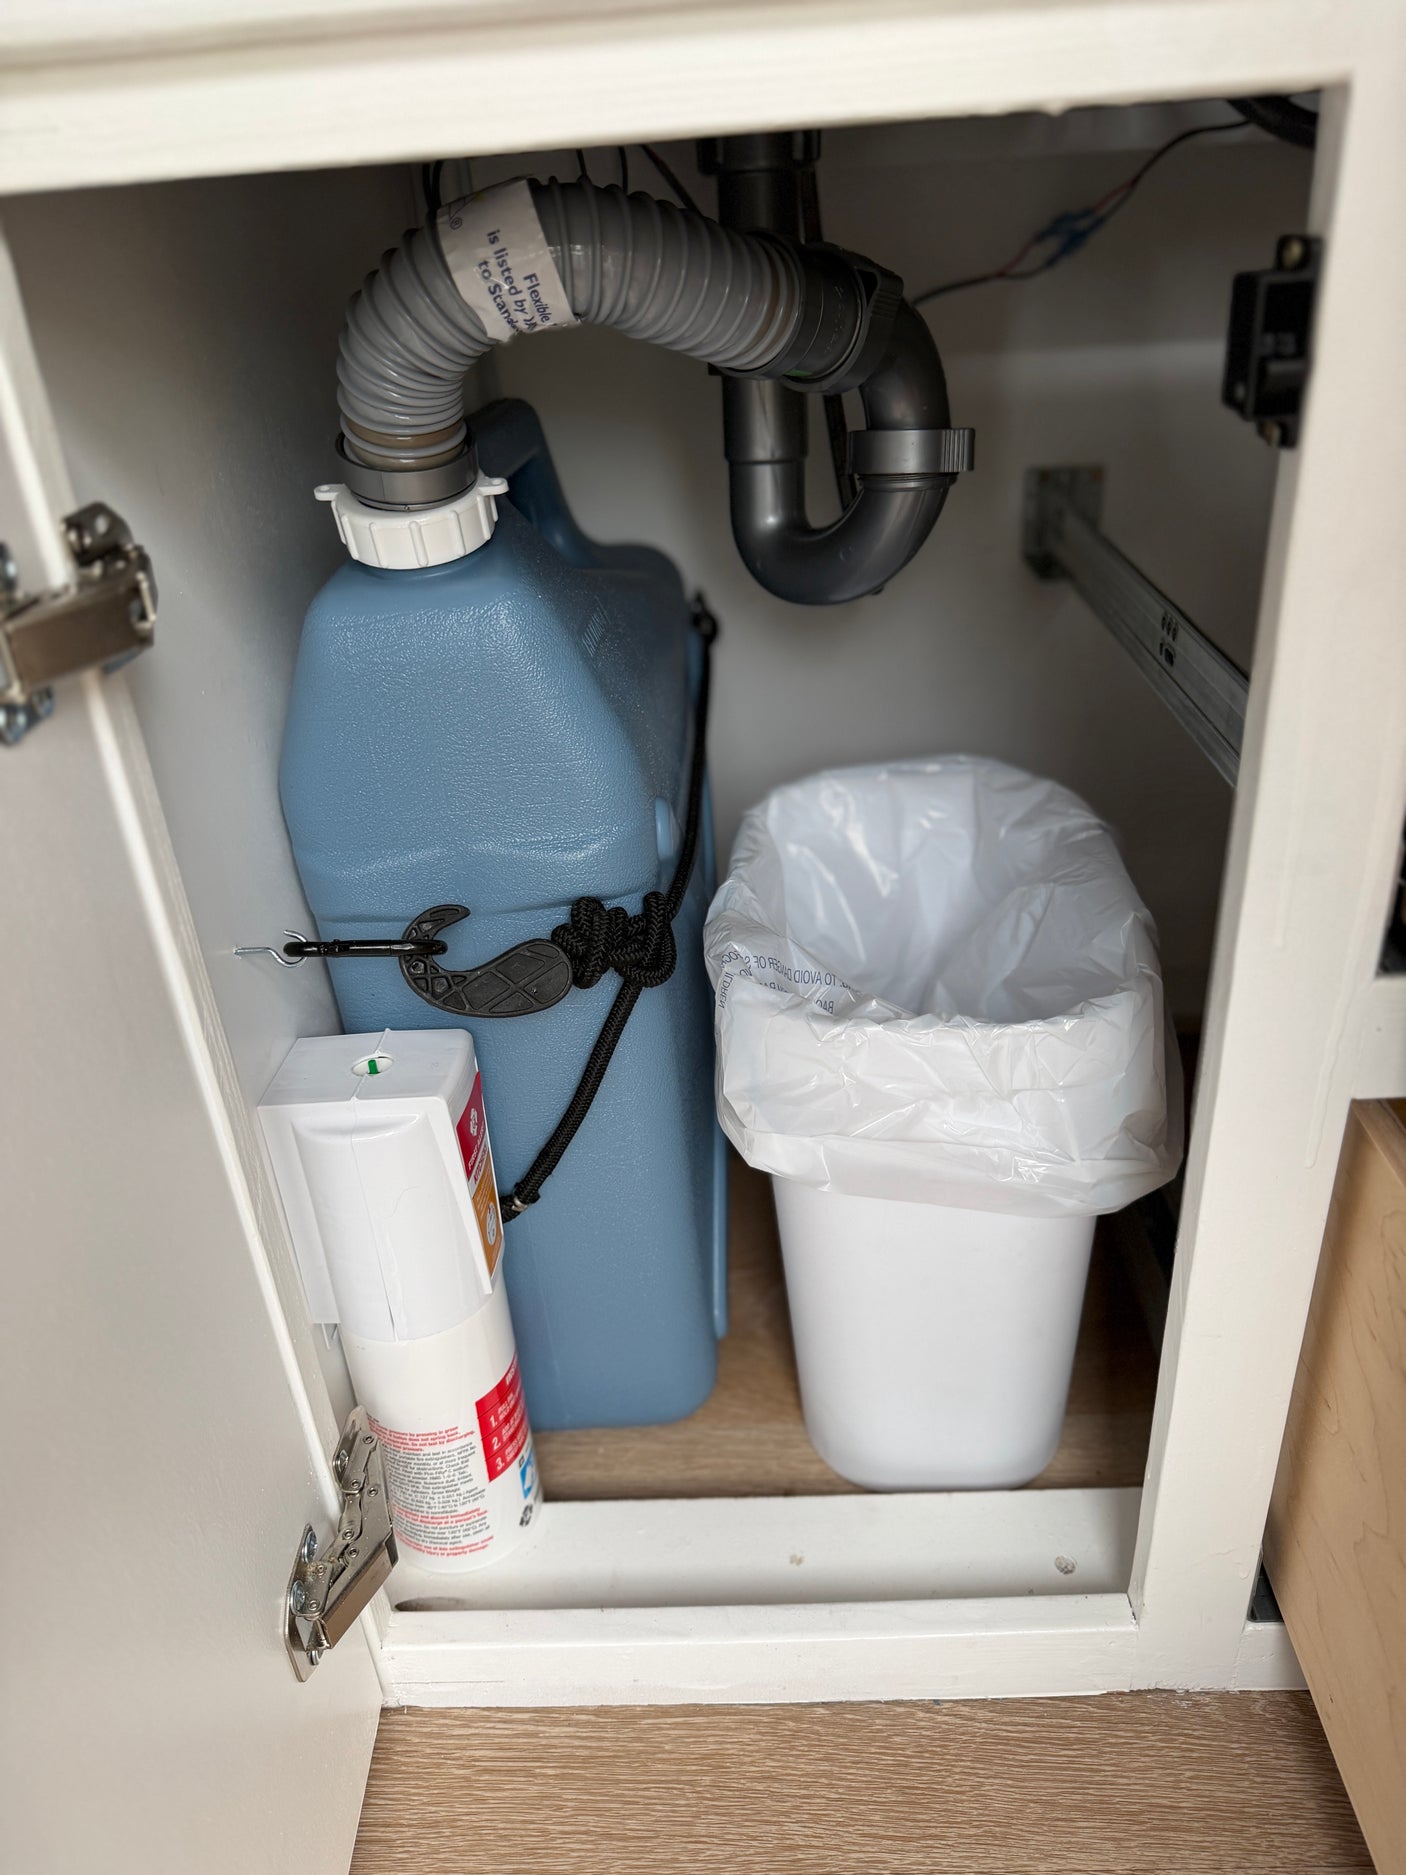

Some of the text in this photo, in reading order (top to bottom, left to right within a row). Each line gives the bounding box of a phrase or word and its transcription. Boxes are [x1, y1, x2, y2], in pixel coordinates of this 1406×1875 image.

[478, 260, 492, 280] to
[487, 229, 500, 245] is
[494, 248, 523, 296] listed
[514, 299, 528, 315] by
[523, 273, 552, 323] Flexible
[490, 1415, 498, 1427] 1.
[492, 1437, 501, 1451] 2.
[495, 1457, 505, 1471] 3.
